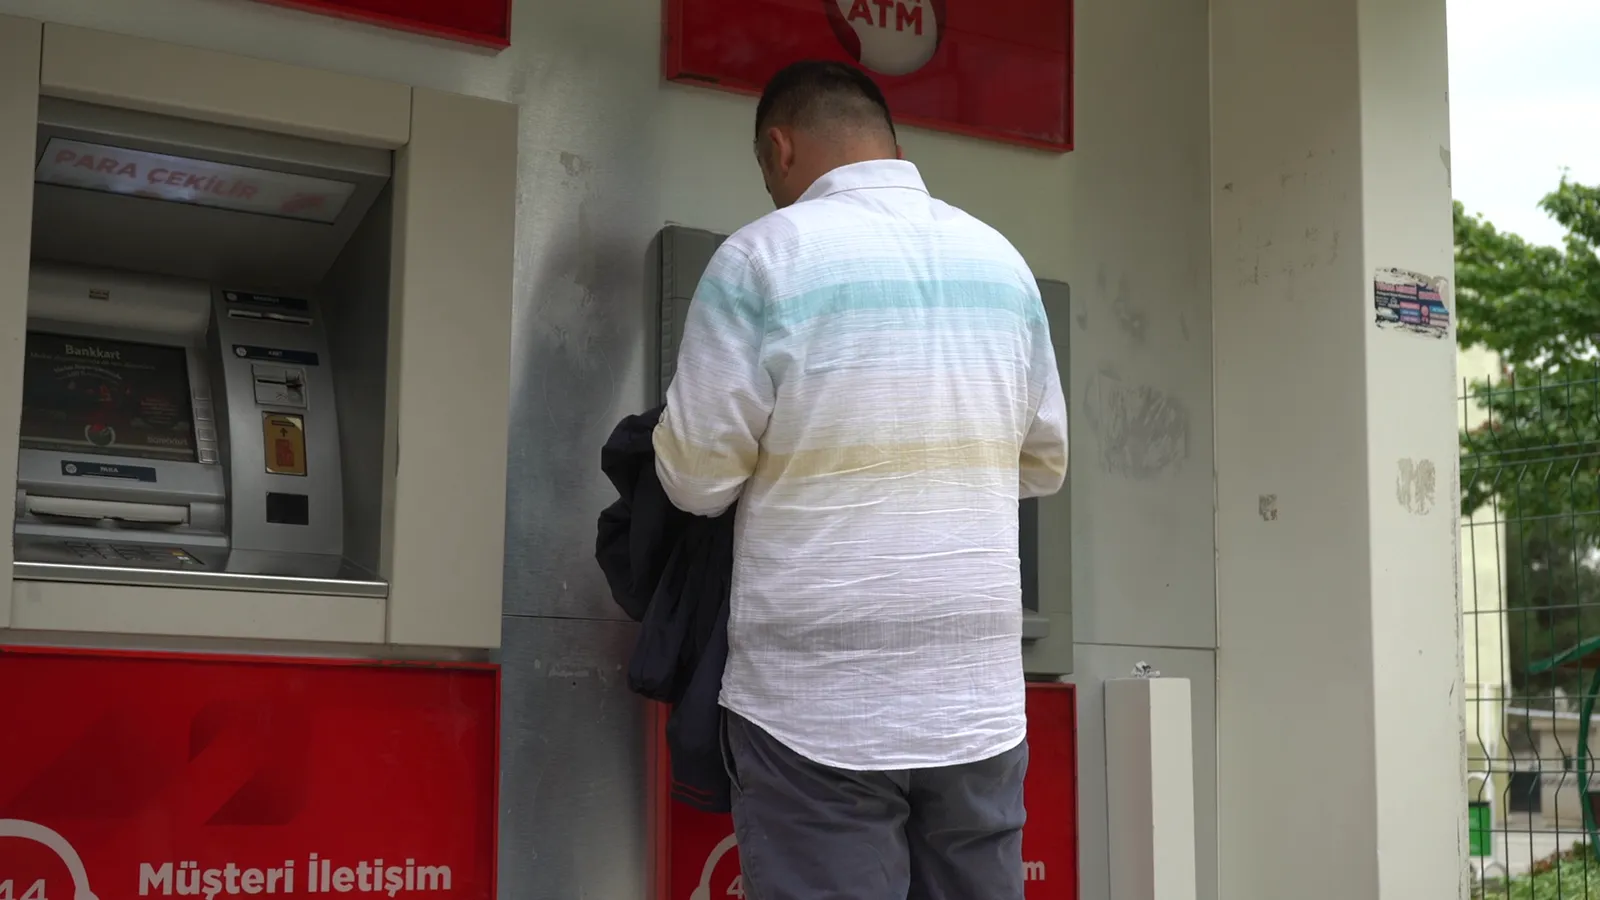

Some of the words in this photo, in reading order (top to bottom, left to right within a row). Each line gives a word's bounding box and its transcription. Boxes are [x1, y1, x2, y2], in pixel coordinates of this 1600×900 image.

[848, 0, 922, 36] ATM
[54, 149, 137, 178] PARA
[146, 168, 259, 200] ÇEKİLİR
[65, 343, 121, 360] Bankkart
[139, 860, 294, 900] Müşteri
[307, 853, 451, 898] İletişim
